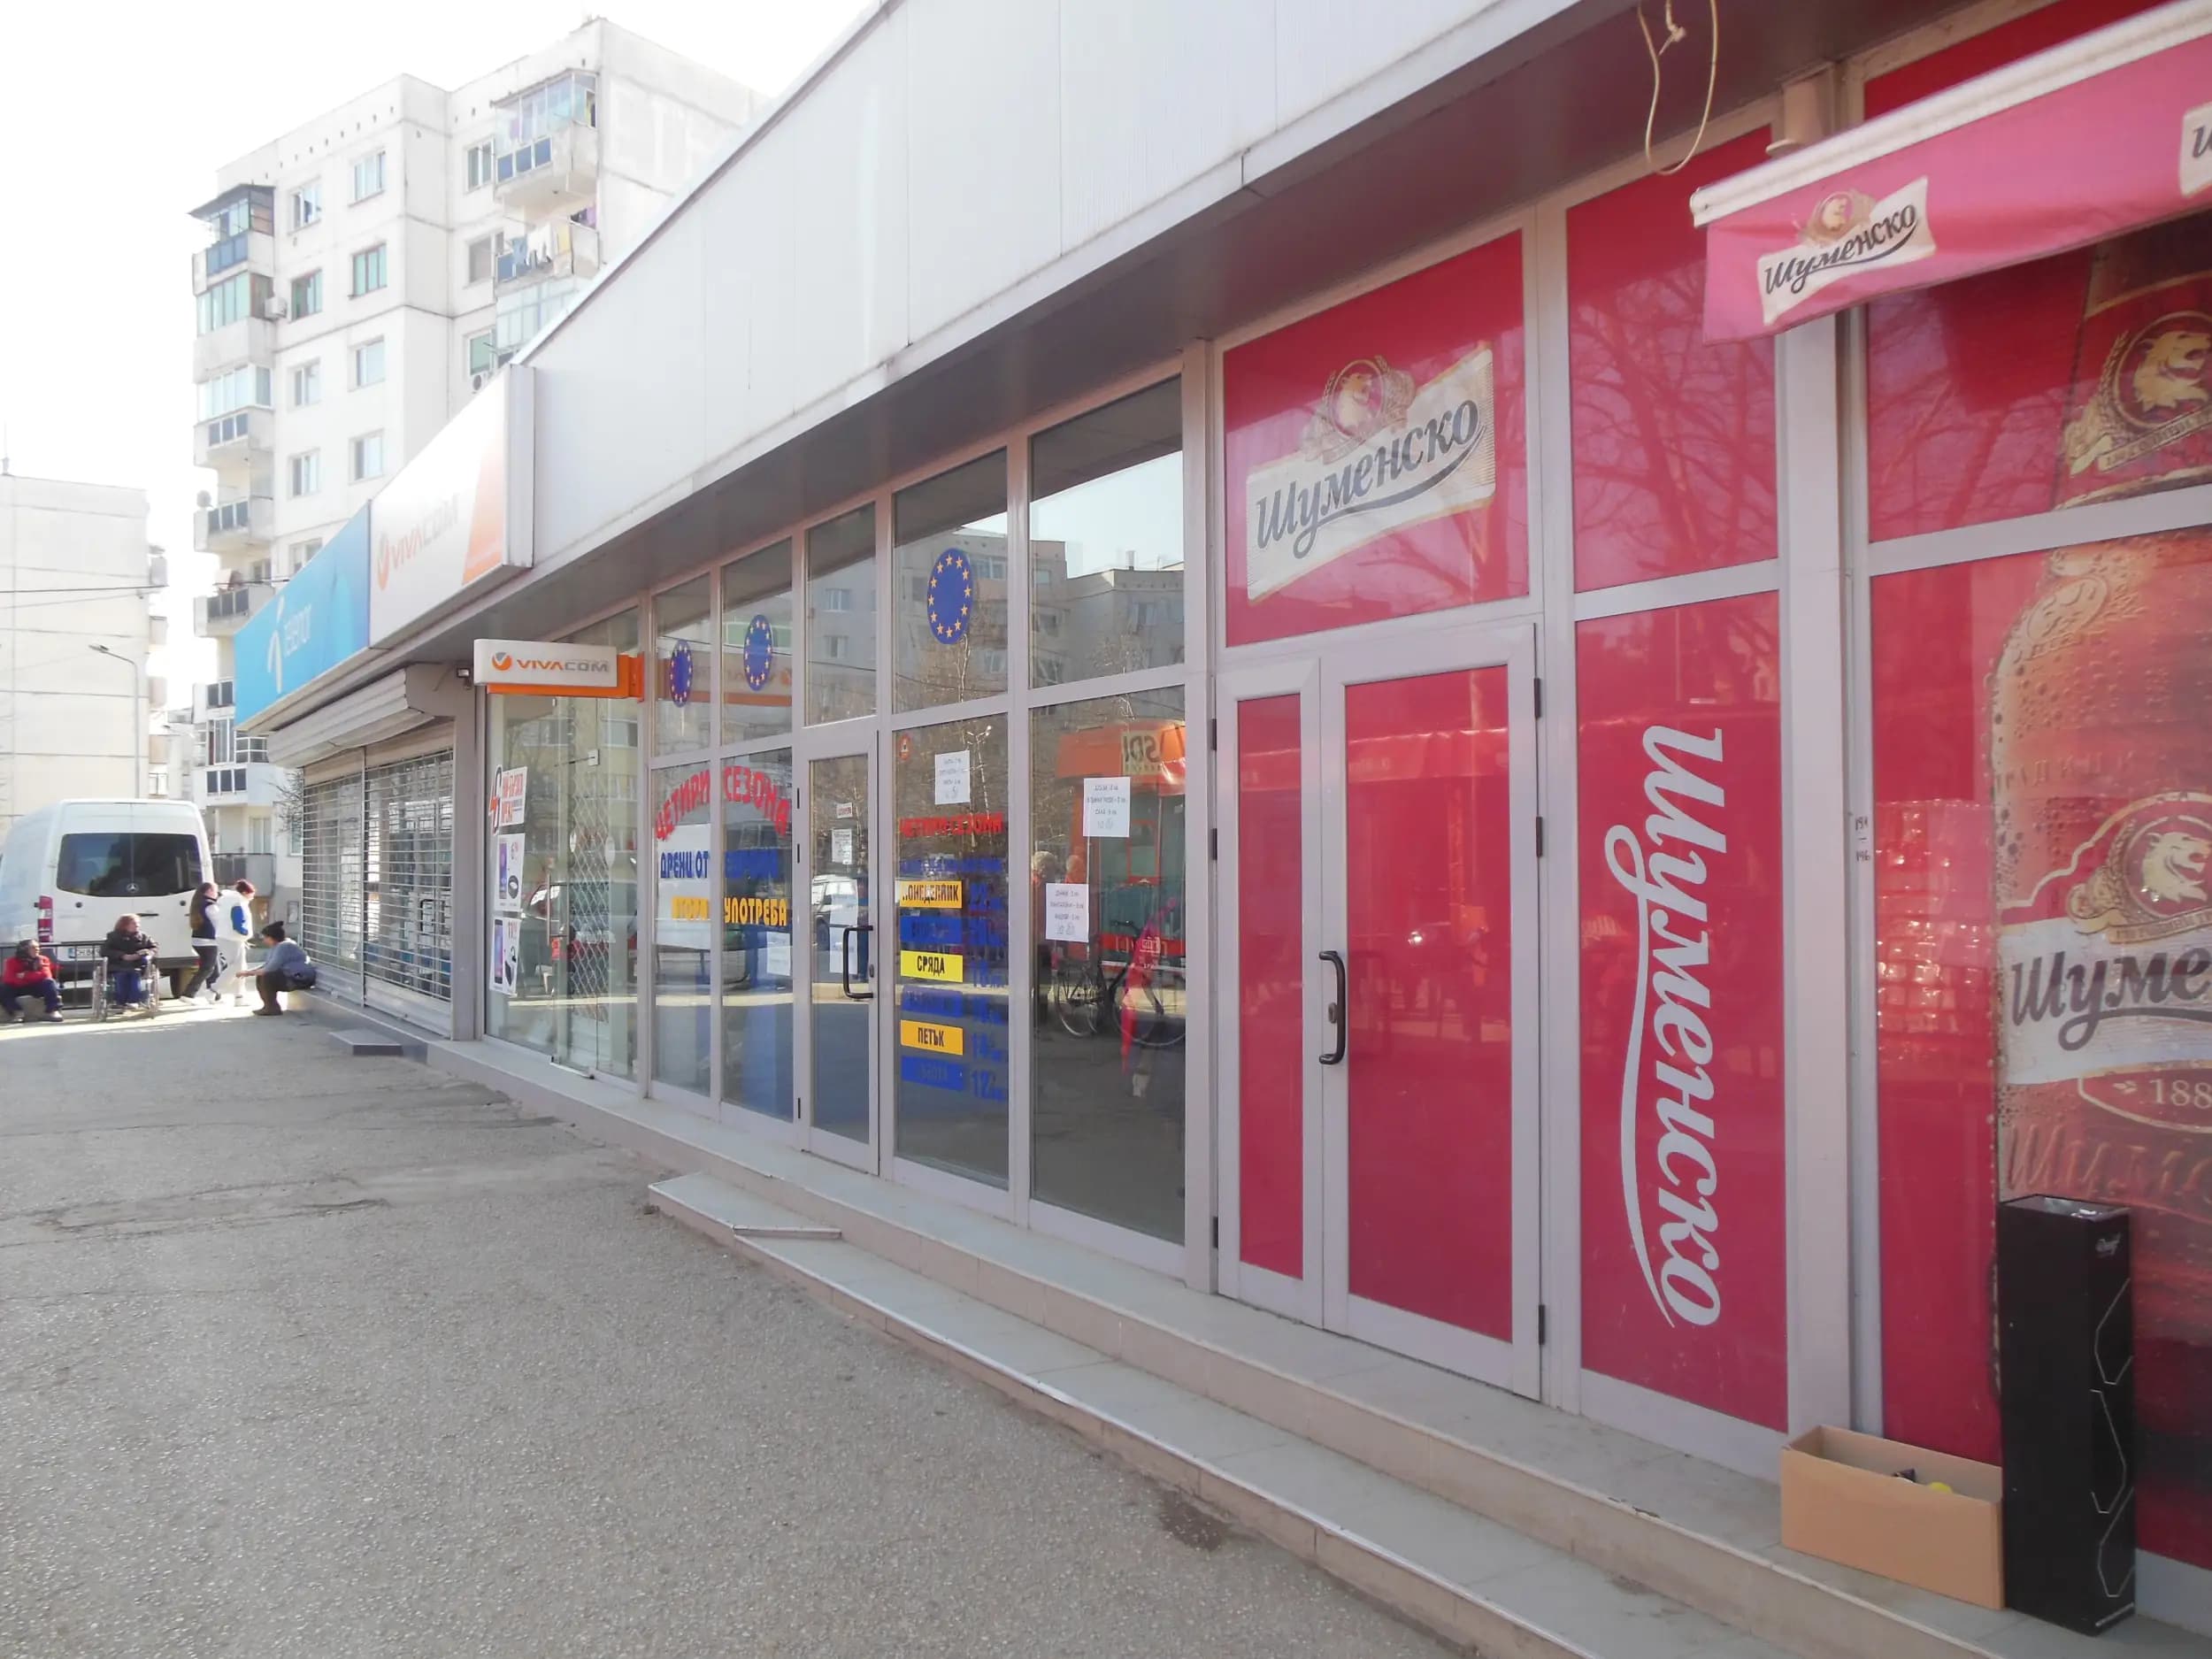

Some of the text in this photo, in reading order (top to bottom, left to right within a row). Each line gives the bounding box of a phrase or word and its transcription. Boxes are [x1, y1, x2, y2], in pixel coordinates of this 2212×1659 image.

[1764, 204, 1918, 294] Шуменско
[1256, 399, 1486, 558] Шуменско
[391, 493, 458, 570] VIVACOM
[517, 658, 609, 672] VIVACOM
[724, 765, 790, 837] СЕЗОНА
[695, 850, 710, 879] ОТ
[724, 897, 788, 926] УПОТРЕБА
[917, 956, 945, 977] СРЯДА
[918, 1027, 944, 1047] ПЕТЪК
[1604, 725, 1726, 1327] Шуменско
